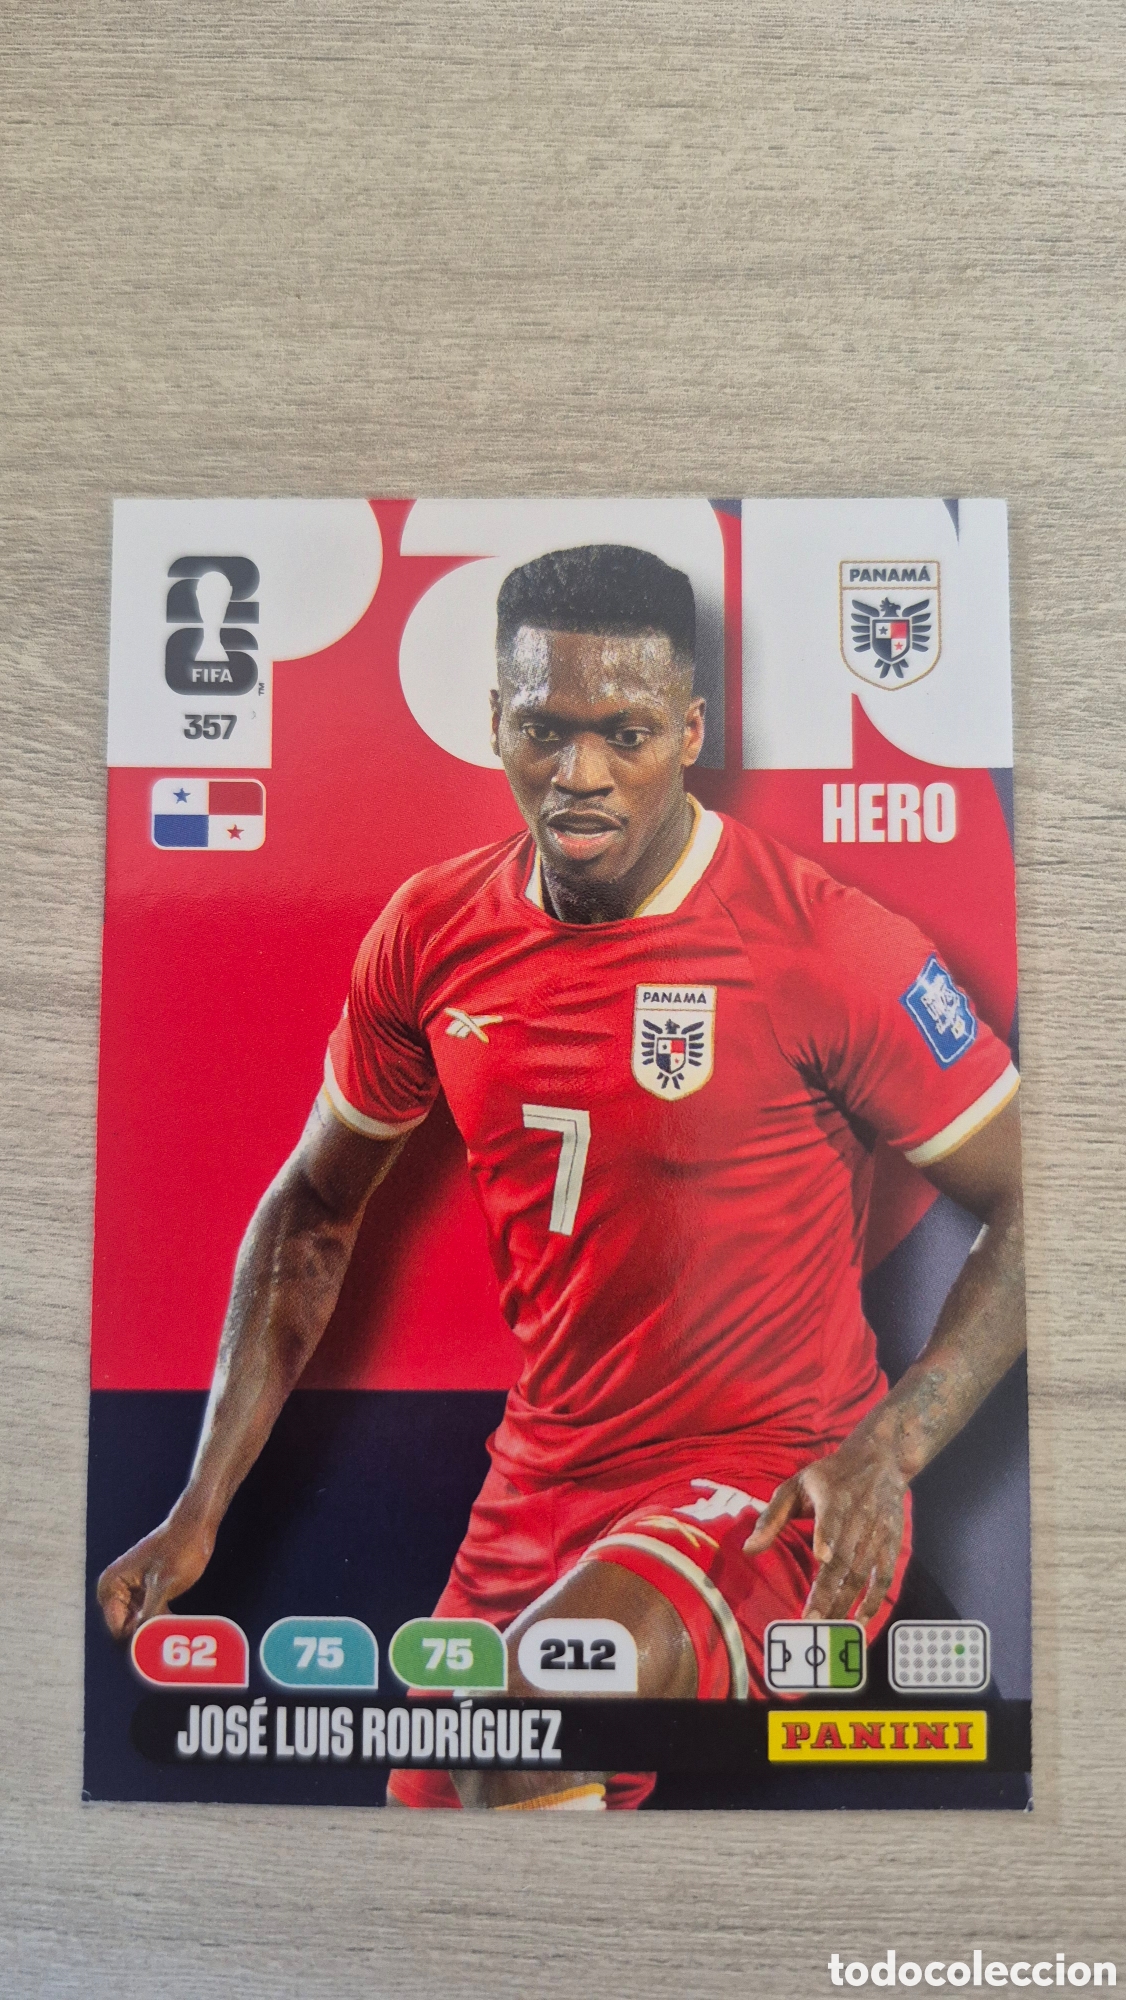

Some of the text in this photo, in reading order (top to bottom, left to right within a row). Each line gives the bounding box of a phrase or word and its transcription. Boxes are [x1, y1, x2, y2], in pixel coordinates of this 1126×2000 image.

[848, 565, 932, 584] PANAMÁ
[191, 668, 233, 683] FIFA
[183, 714, 238, 740] 357
[822, 782, 957, 844] HERO
[522, 1104, 591, 1236] 7
[162, 1634, 218, 1668] 62
[293, 1636, 345, 1669] 75
[422, 1638, 474, 1671] 75
[540, 1639, 616, 1671] 212
[177, 1696, 562, 1760] JOSÉ LUIS RODRÍGUEZ
[781, 1722, 974, 1750] PANINI
